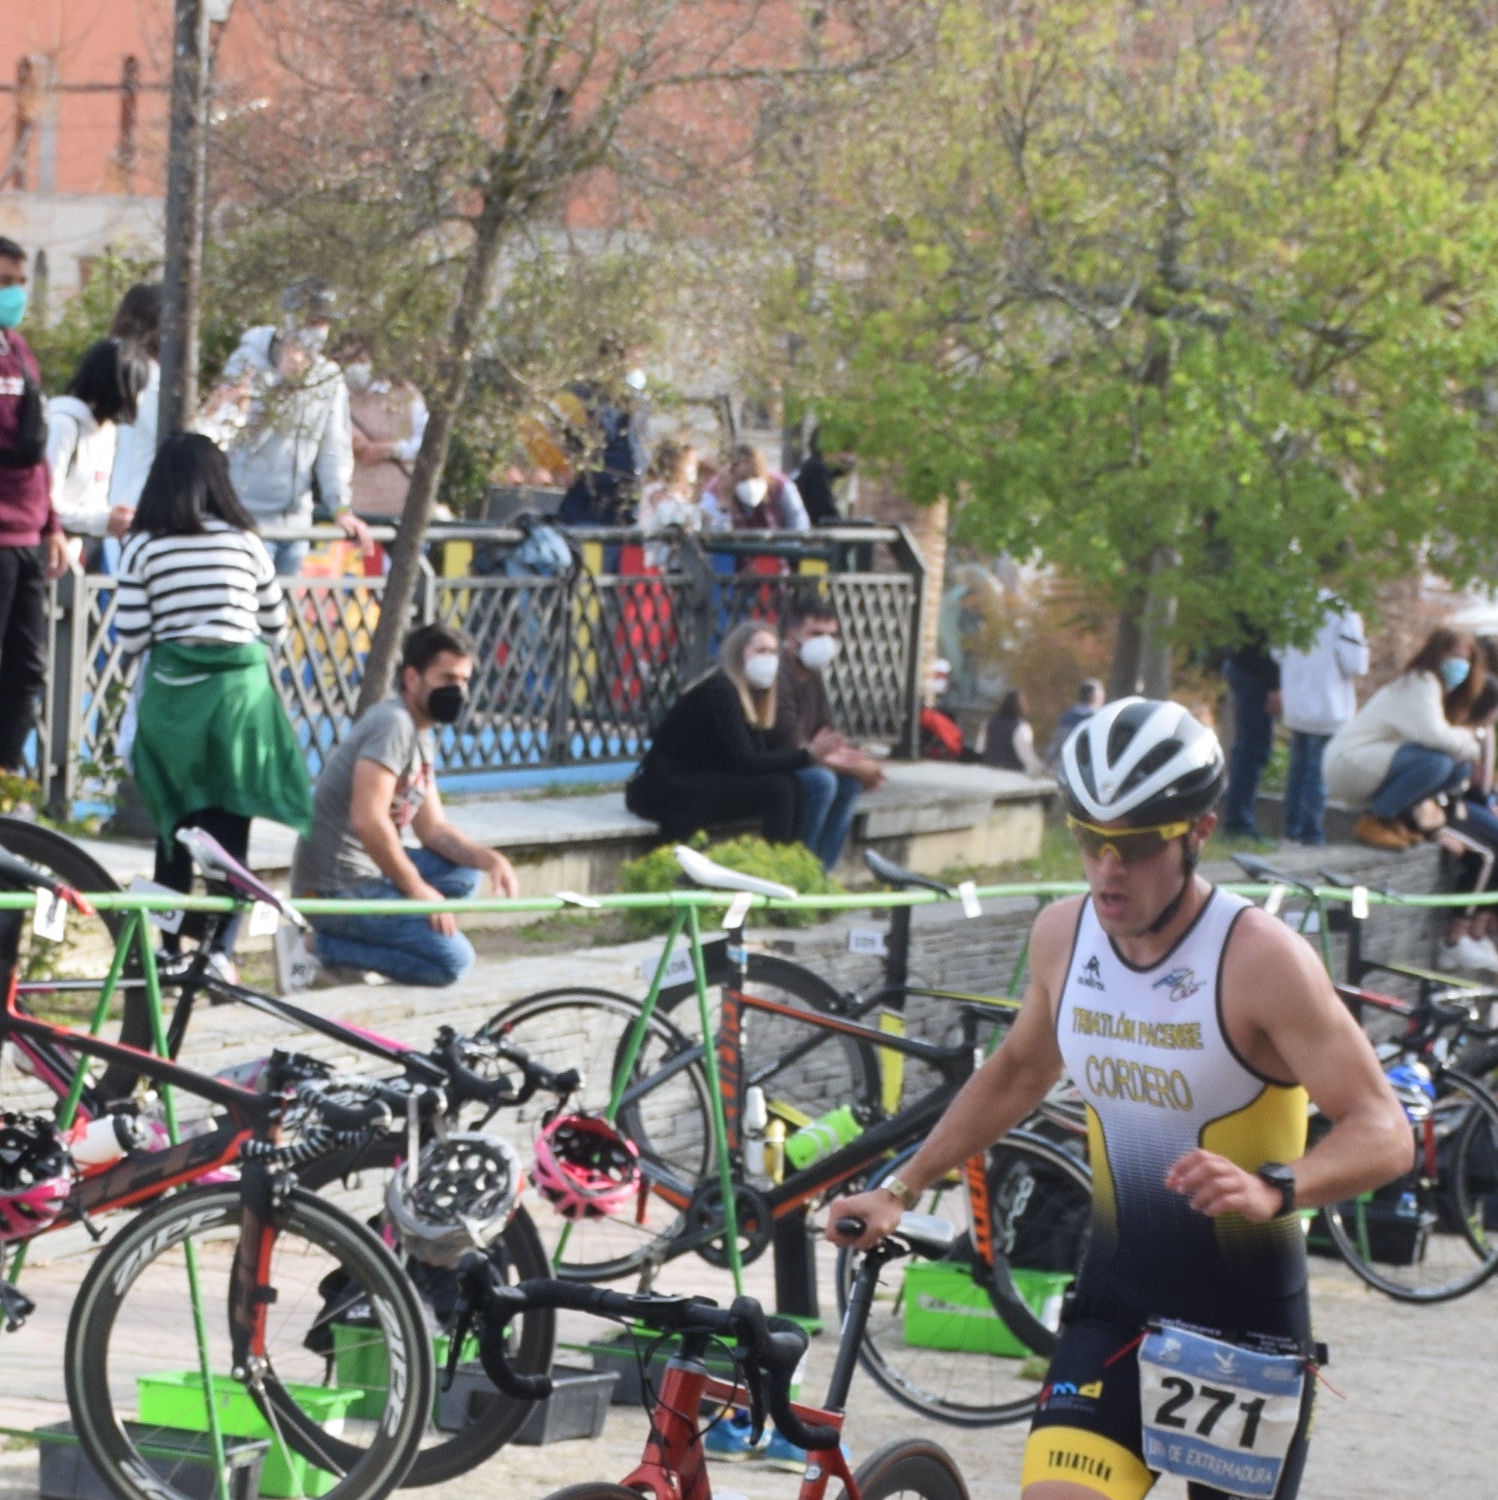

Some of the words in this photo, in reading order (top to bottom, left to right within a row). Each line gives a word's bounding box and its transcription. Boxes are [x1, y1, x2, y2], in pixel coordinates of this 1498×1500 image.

[1072, 1007, 1136, 1044] TRIATLÓN
[1138, 1021, 1205, 1051] PACENSE
[1085, 1055, 1194, 1113] CORDERO
[114, 1207, 227, 1297] ZIPP
[1154, 1376, 1266, 1450] 271
[1048, 1449, 1112, 1482] TRIATLÓN
[1187, 1448, 1273, 1484] EXTREMADURA
